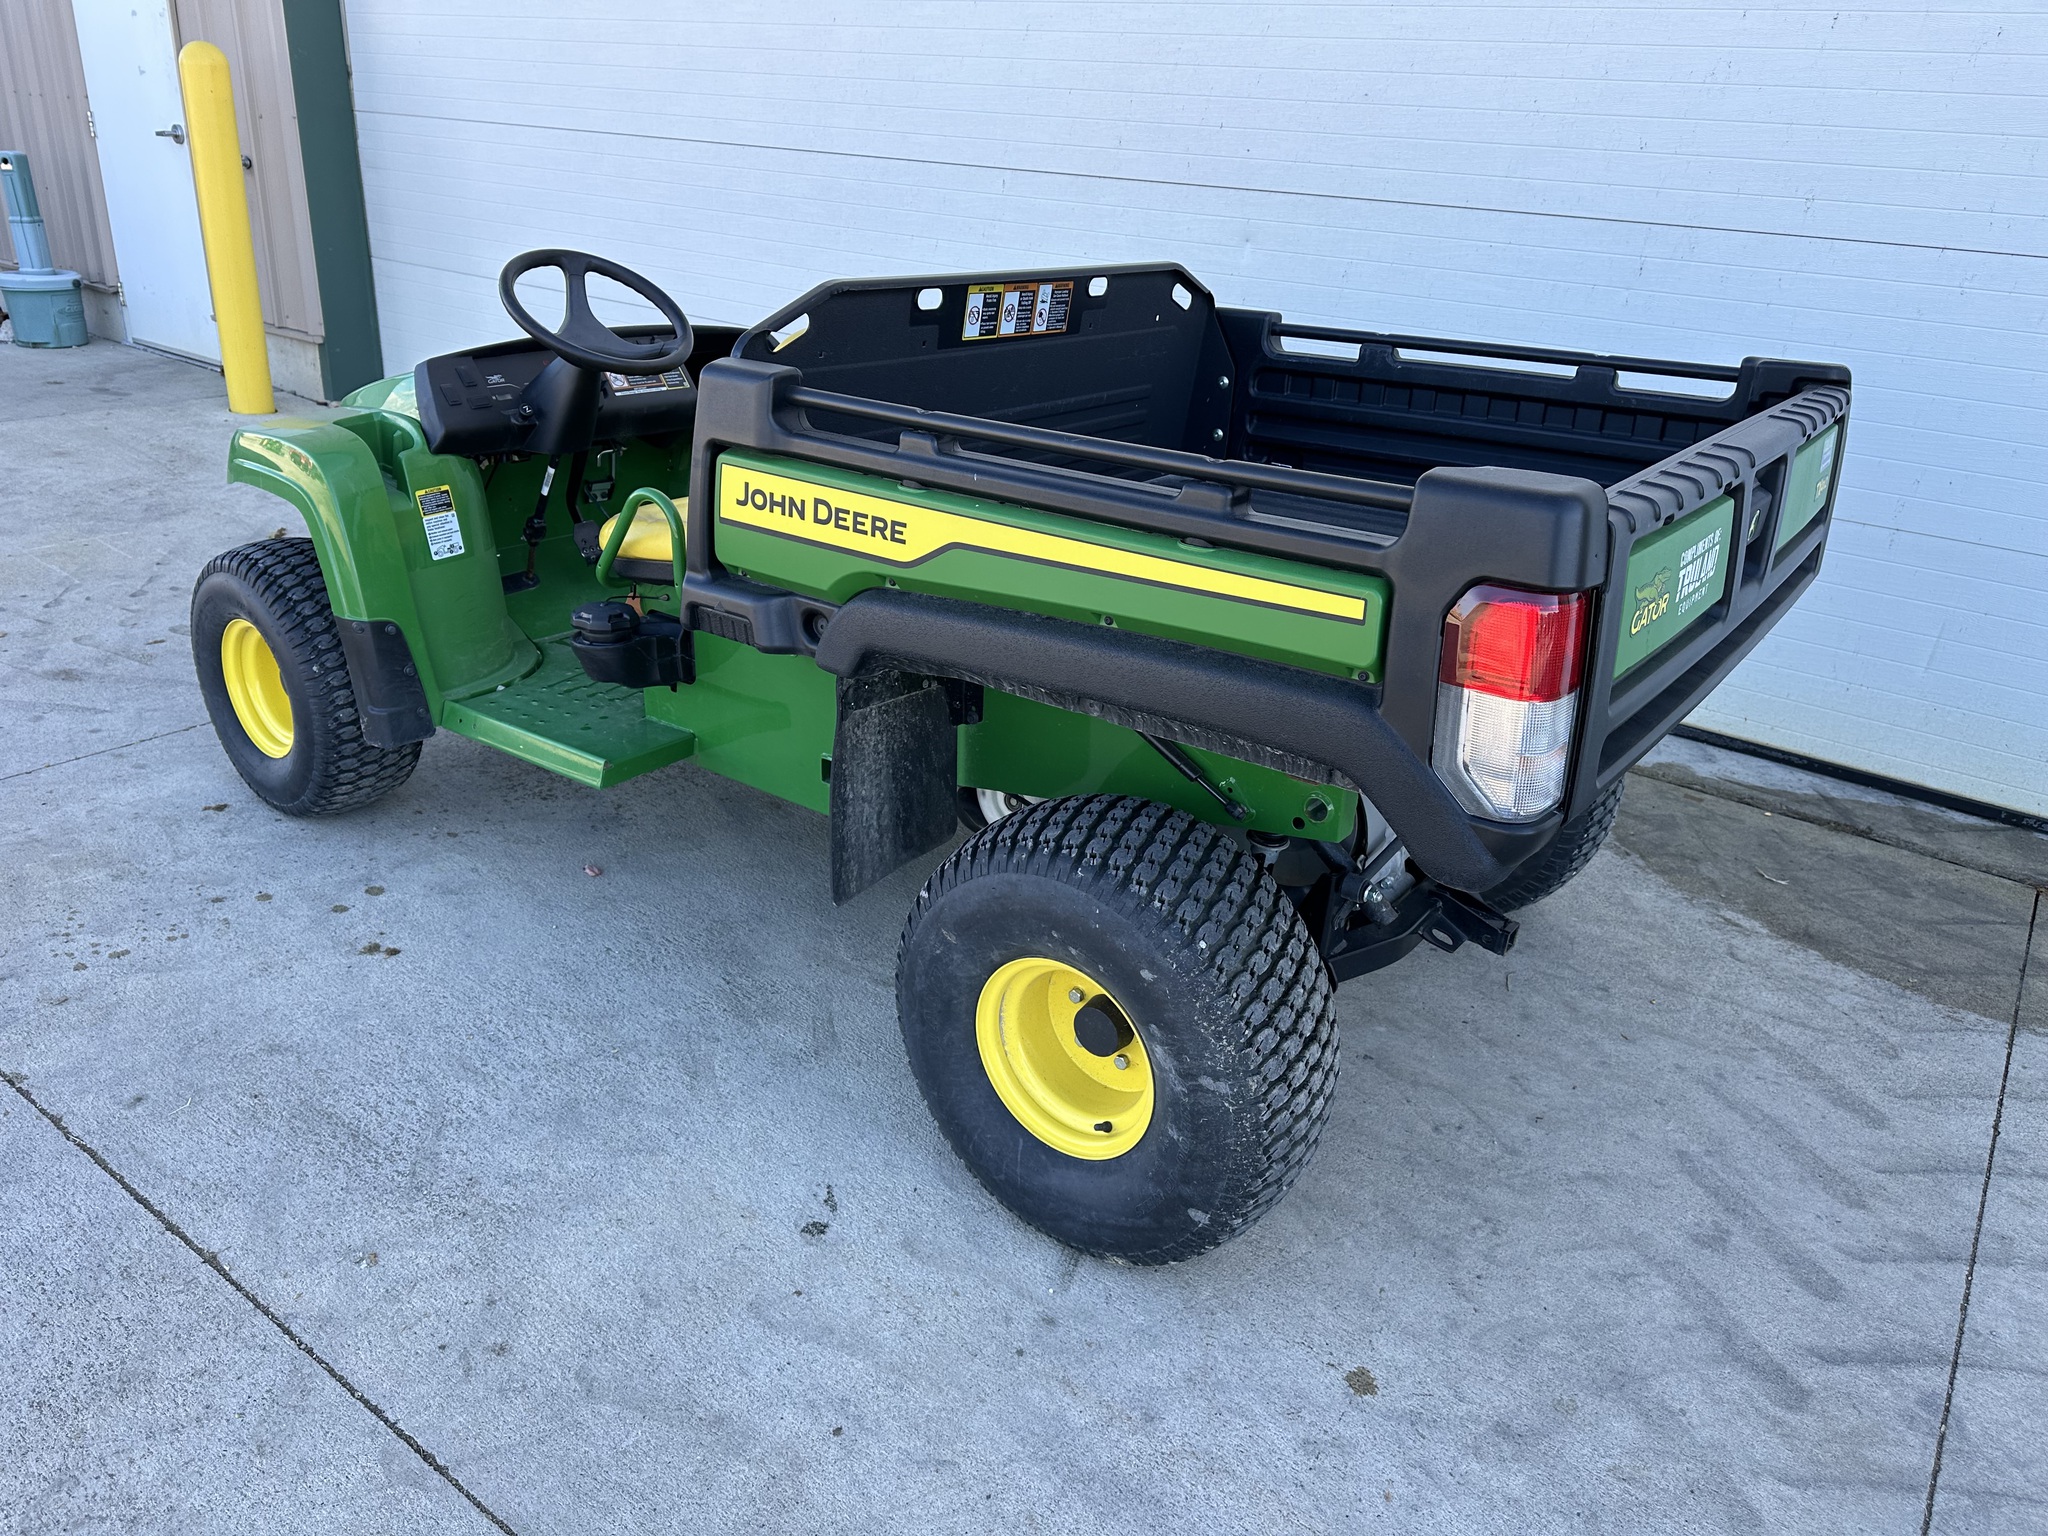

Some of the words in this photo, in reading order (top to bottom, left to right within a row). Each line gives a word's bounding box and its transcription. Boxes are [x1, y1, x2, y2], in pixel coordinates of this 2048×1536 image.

[736, 481, 806, 521] JOHN
[813, 497, 907, 545] DEERE
[1680, 532, 1714, 567] COMPLIMENTS
[1630, 592, 1670, 636] GATOR
[1678, 583, 1709, 616] EQUIPMENT
